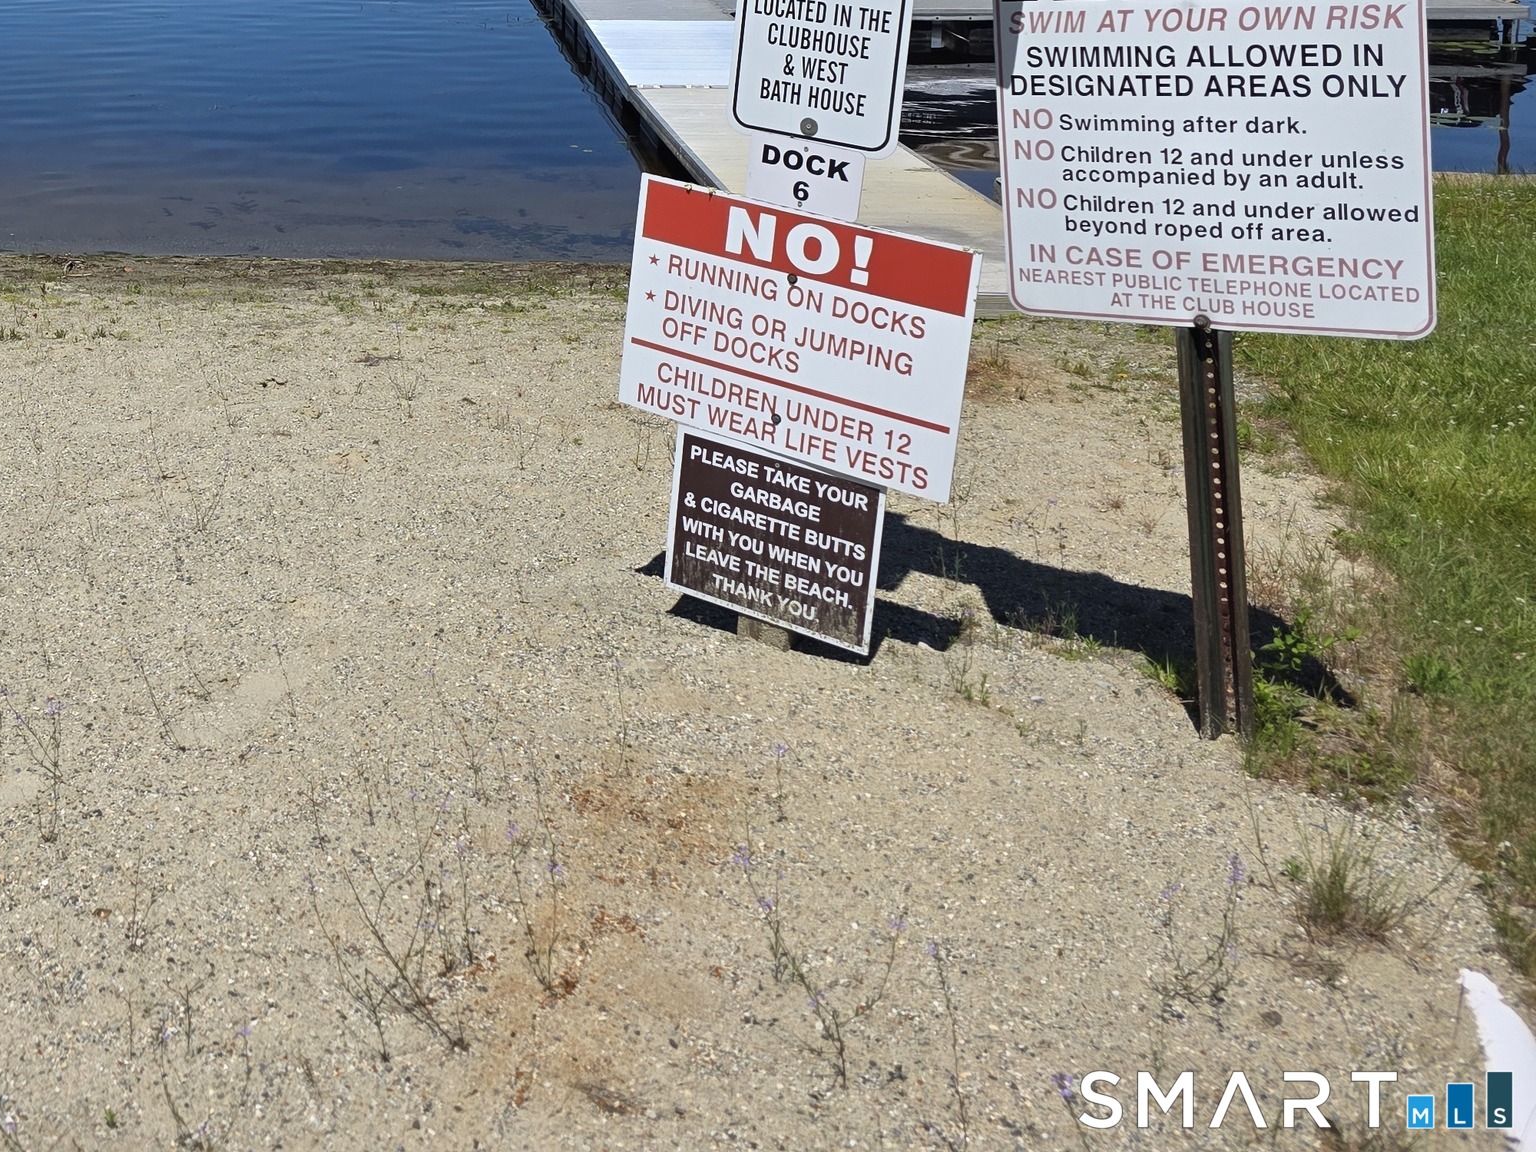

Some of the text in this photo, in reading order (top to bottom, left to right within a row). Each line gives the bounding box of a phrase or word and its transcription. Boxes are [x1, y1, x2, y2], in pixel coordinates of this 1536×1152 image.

[833, 3, 852, 27] IN
[858, 7, 892, 33] THE
[1009, 3, 1407, 35] SWIM AT YOUR OWN RISK
[768, 23, 871, 60] CLUBHOUSE
[1026, 43, 1383, 69] SWIMMING ALLOWED IN
[783, 54, 848, 84] & WEST
[1010, 74, 1407, 98] DESIGNATED AREAS ONLY
[760, 78, 866, 116] BATH HOUSE
[1012, 108, 1307, 137] NO Swimming after dark.
[761, 144, 851, 182] DOCK
[1014, 139, 1404, 170] NO Children 12 and under unless
[792, 181, 810, 201] 6
[1061, 166, 1364, 191] accompanied by an adult.
[1016, 188, 1419, 224] NO Children 12 and under allowed
[725, 206, 874, 286] NO!
[1064, 216, 1332, 243] beyond roped off area.
[1029, 244, 1405, 280] IN CASE OF EMERGENCY
[668, 254, 926, 339] RUNNING ON DOCKS
[1018, 268, 1420, 303] NEAREST PUBLIC TELEPHONE LOCATED
[1110, 292, 1315, 319] AT THE CLUB HOUSE
[663, 318, 800, 373] OFF DOCKS
[664, 290, 913, 376] DIVING OR JUMPING
[657, 363, 912, 455] CHILDREN UNDER 12
[637, 383, 929, 490] MUST WEAR LIFE VESTS
[690, 444, 868, 512] PLEASE TAKE YOUR
[730, 482, 821, 522] GARBAGE
[684, 492, 866, 561] & CIGARETTE BUTTS
[682, 516, 864, 587] WITH YOU WHEN YOU
[685, 541, 853, 609] LEAVE THE BEACH.
[713, 573, 773, 607] THANK
